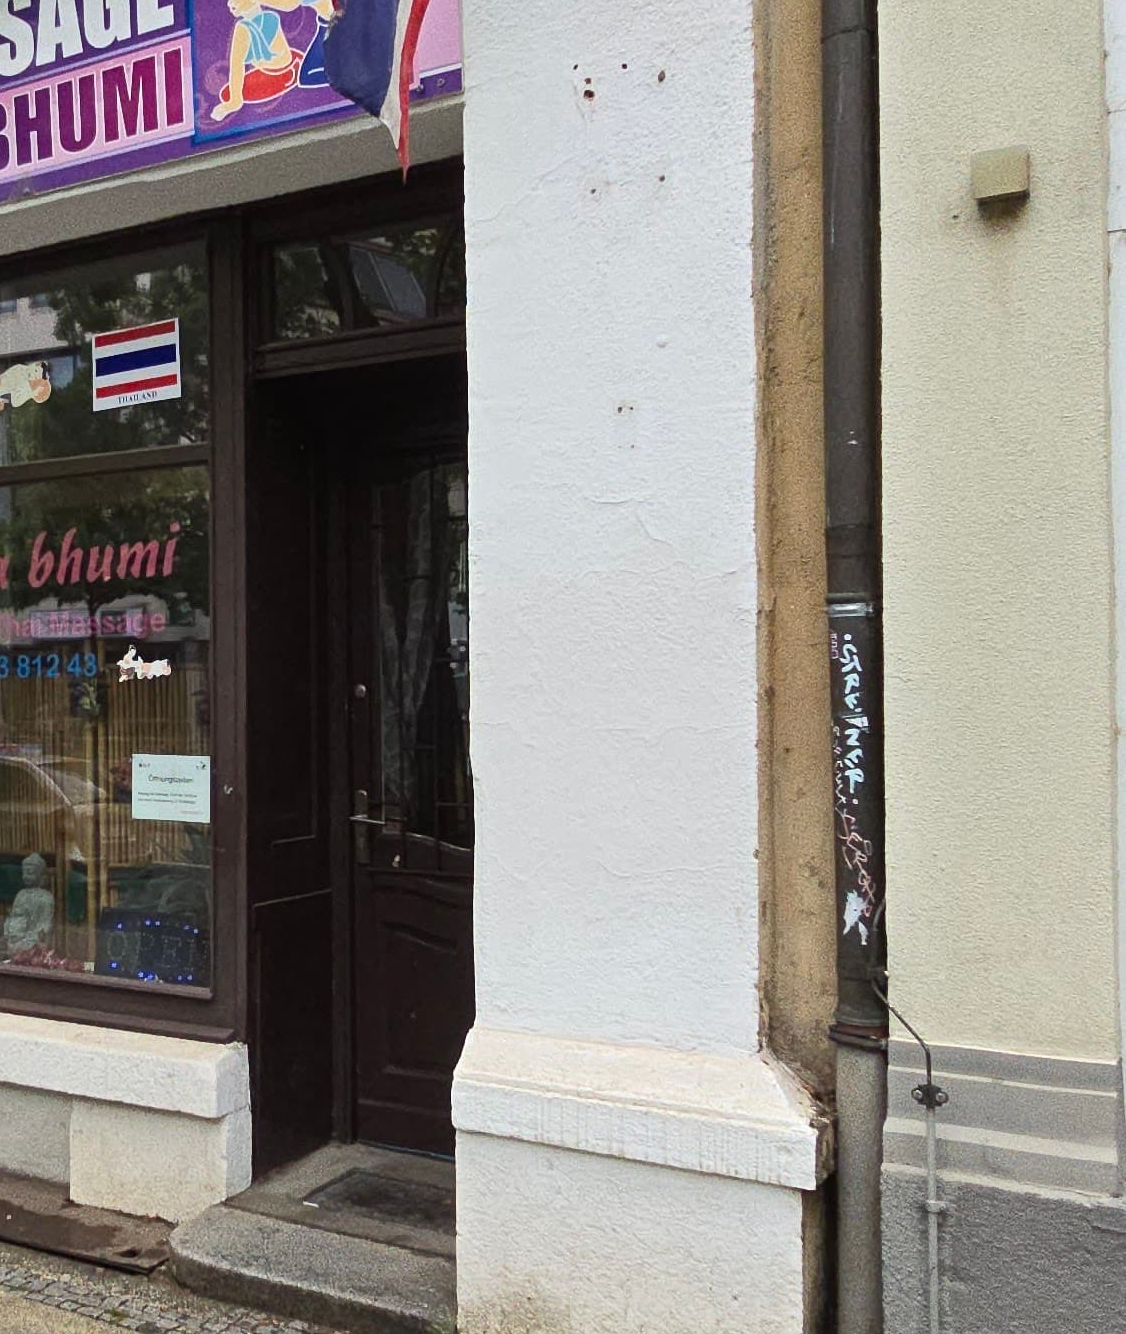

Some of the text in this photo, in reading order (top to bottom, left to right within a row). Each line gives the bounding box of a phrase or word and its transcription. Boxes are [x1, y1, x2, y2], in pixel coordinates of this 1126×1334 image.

[27, 523, 181, 588] bhumi
[16, 654, 59, 678] 812
[67, 653, 98, 677] 43
